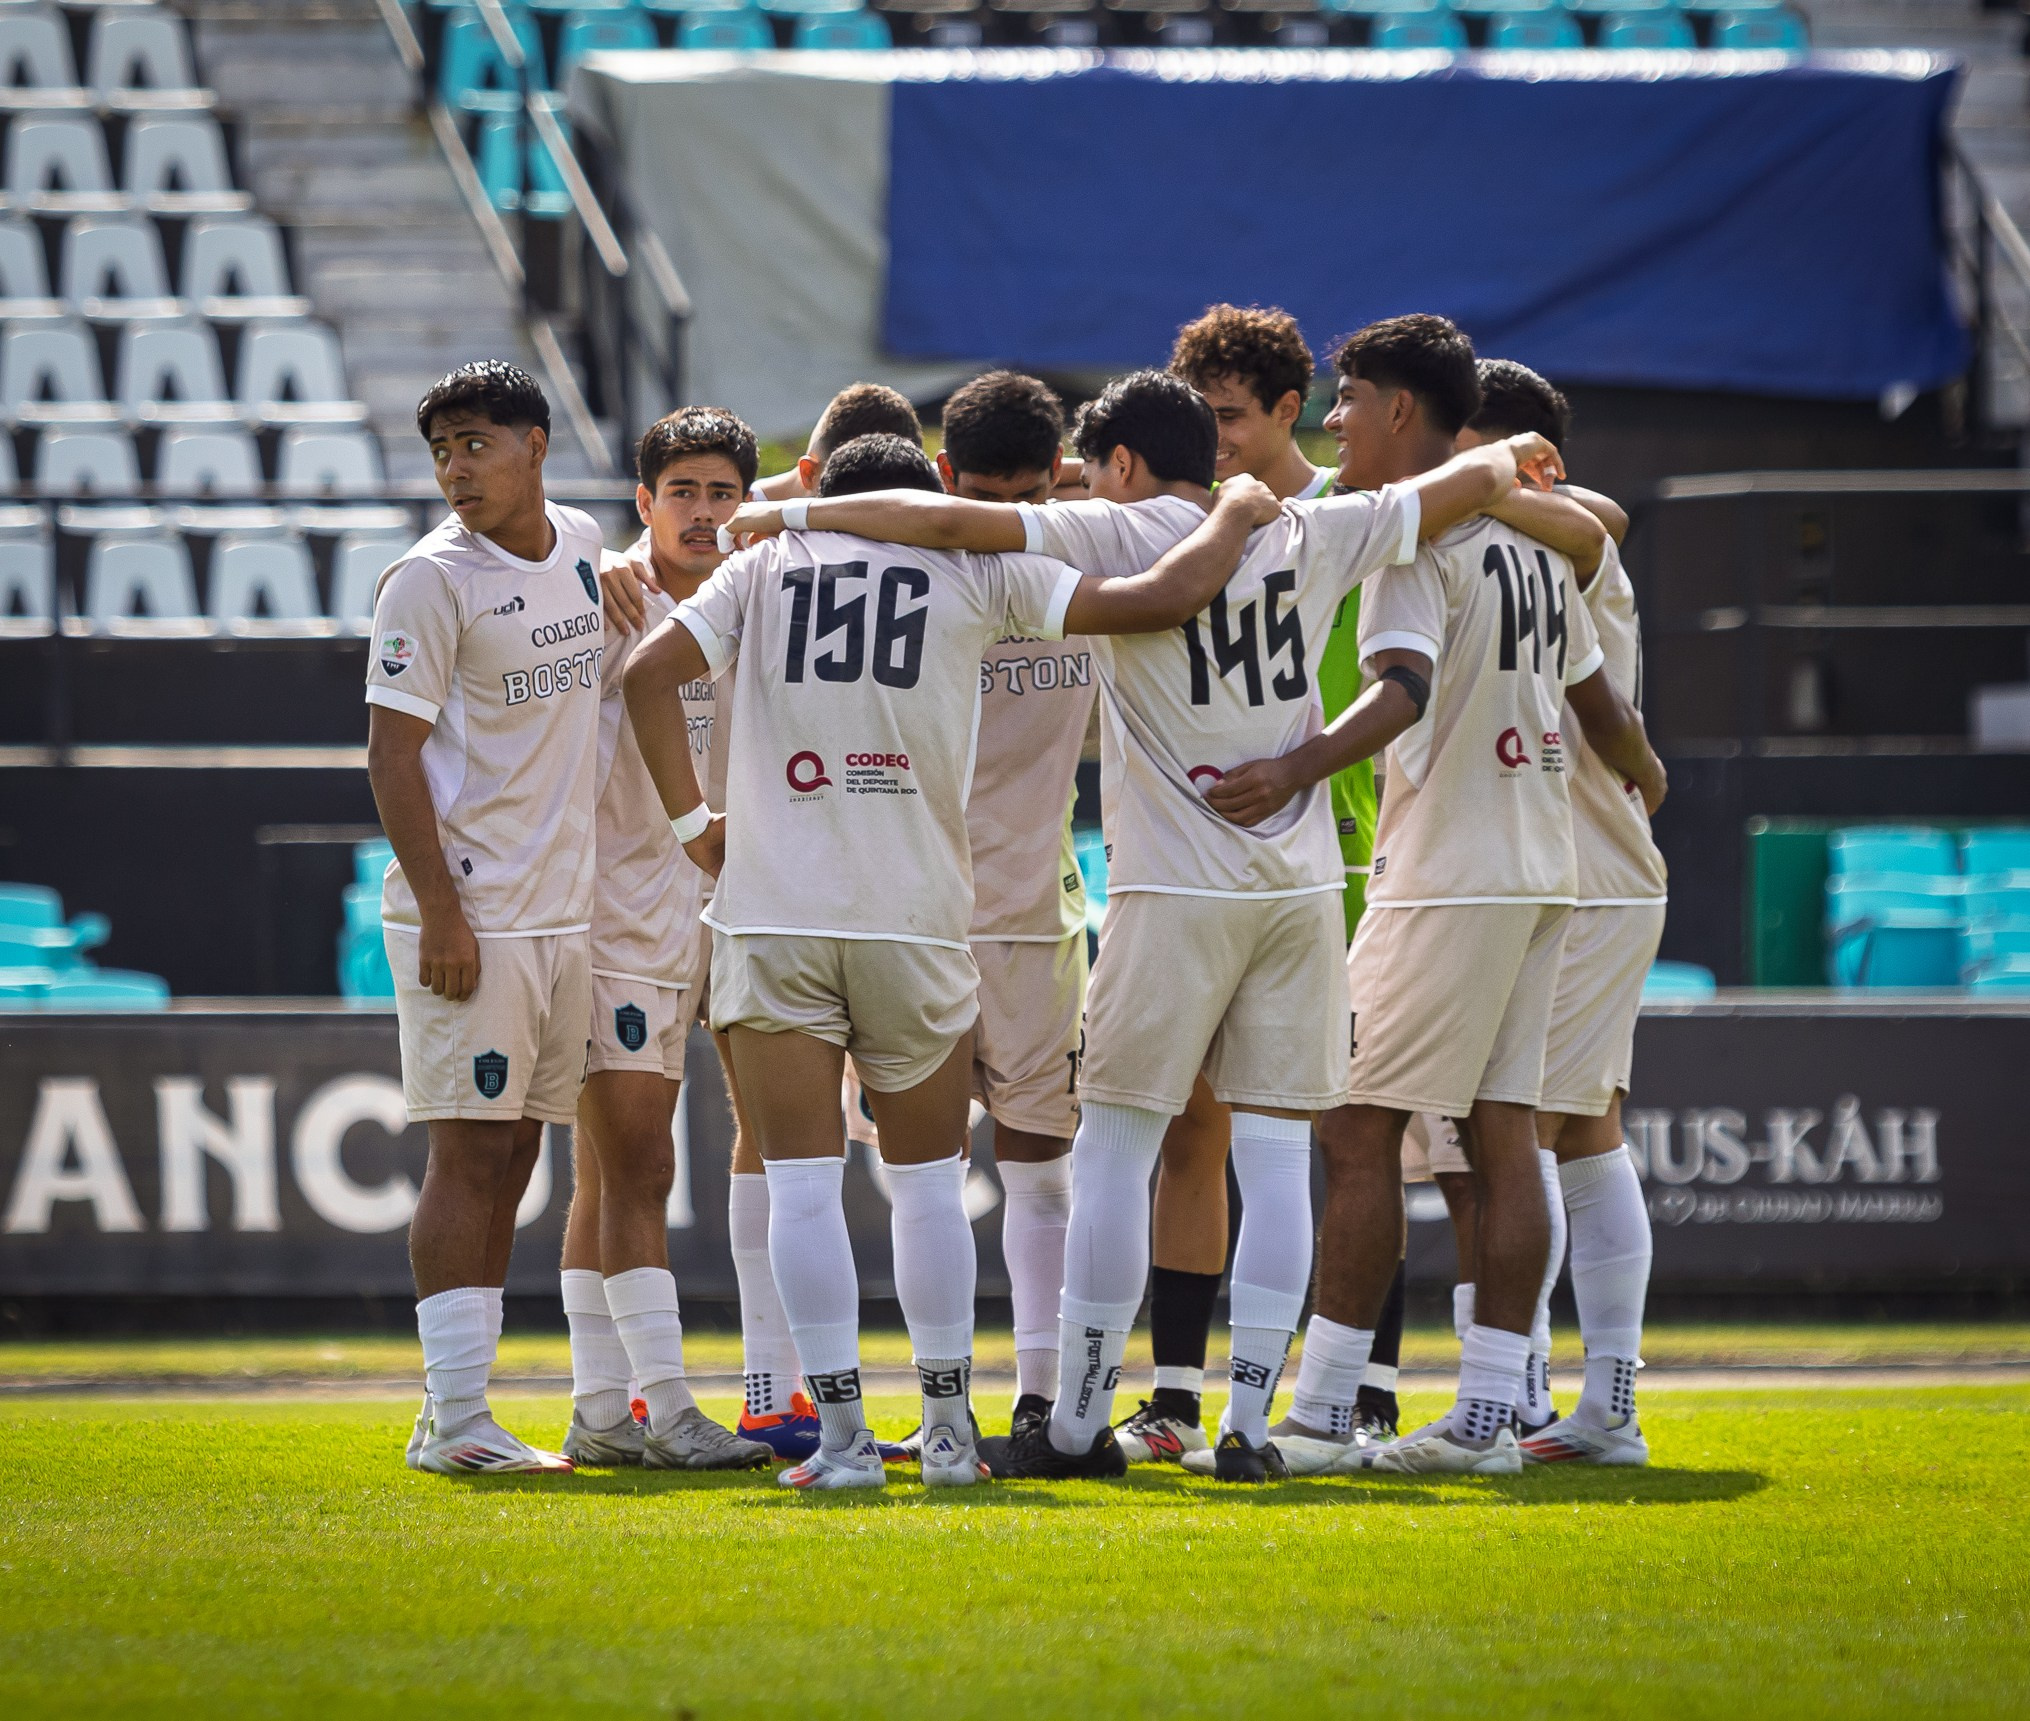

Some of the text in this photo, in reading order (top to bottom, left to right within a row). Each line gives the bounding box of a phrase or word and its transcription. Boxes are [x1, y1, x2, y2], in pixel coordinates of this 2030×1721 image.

[781, 561, 930, 689] 156
[1483, 544, 1567, 680] 144
[531, 612, 600, 648] COLEGIO
[1181, 569, 1308, 707] 145
[845, 753, 910, 770] CODEQ
[846, 769, 884, 777] COMISIÓN
[858, 787, 899, 795] QUINTANA
[814, 1373, 859, 1401] FS
[919, 1370, 958, 1396] FS
